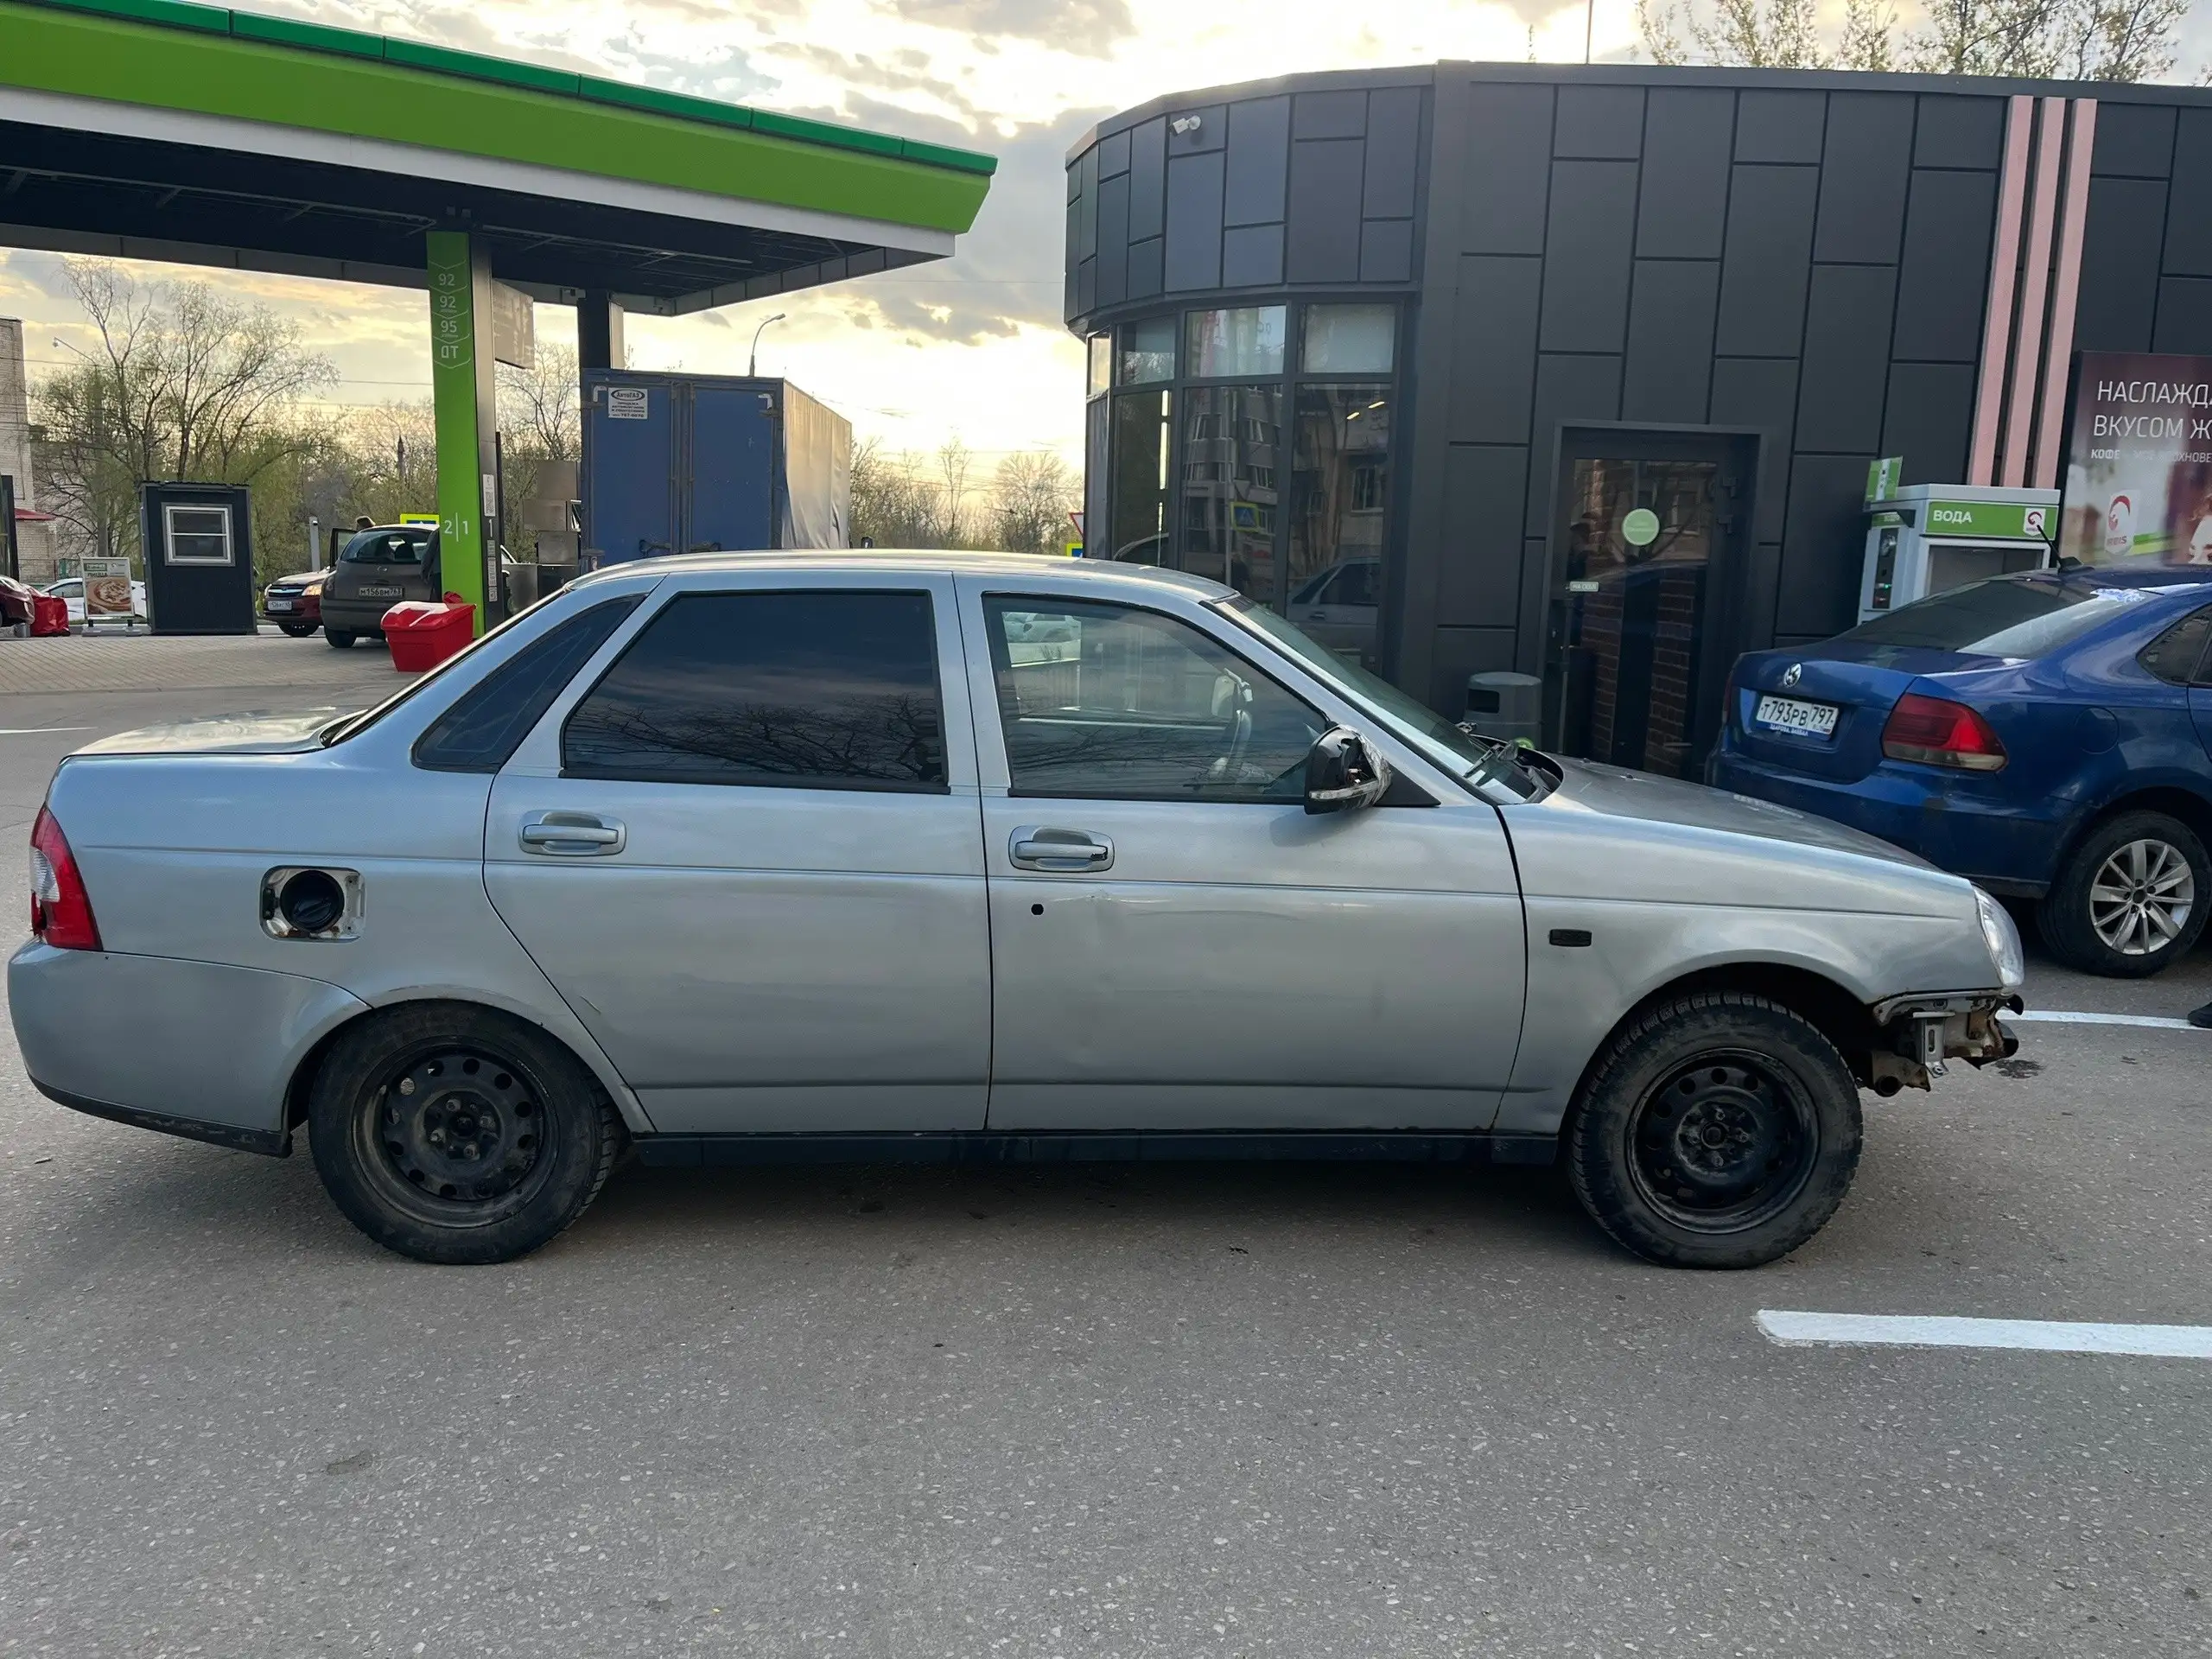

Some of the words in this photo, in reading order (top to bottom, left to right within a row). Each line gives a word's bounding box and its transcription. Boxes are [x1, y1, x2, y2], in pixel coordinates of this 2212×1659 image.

[438, 273, 455, 286] 92
[439, 296, 456, 308] 92
[440, 320, 457, 333] 95
[2097, 380, 2212, 408] НАСЛАЖД
[2093, 415, 2183, 439] ВКУСОМ
[2091, 448, 2120, 460] КОФЕ
[1933, 510, 1973, 524] ВОДА
[1810, 707, 1834, 724] 797
